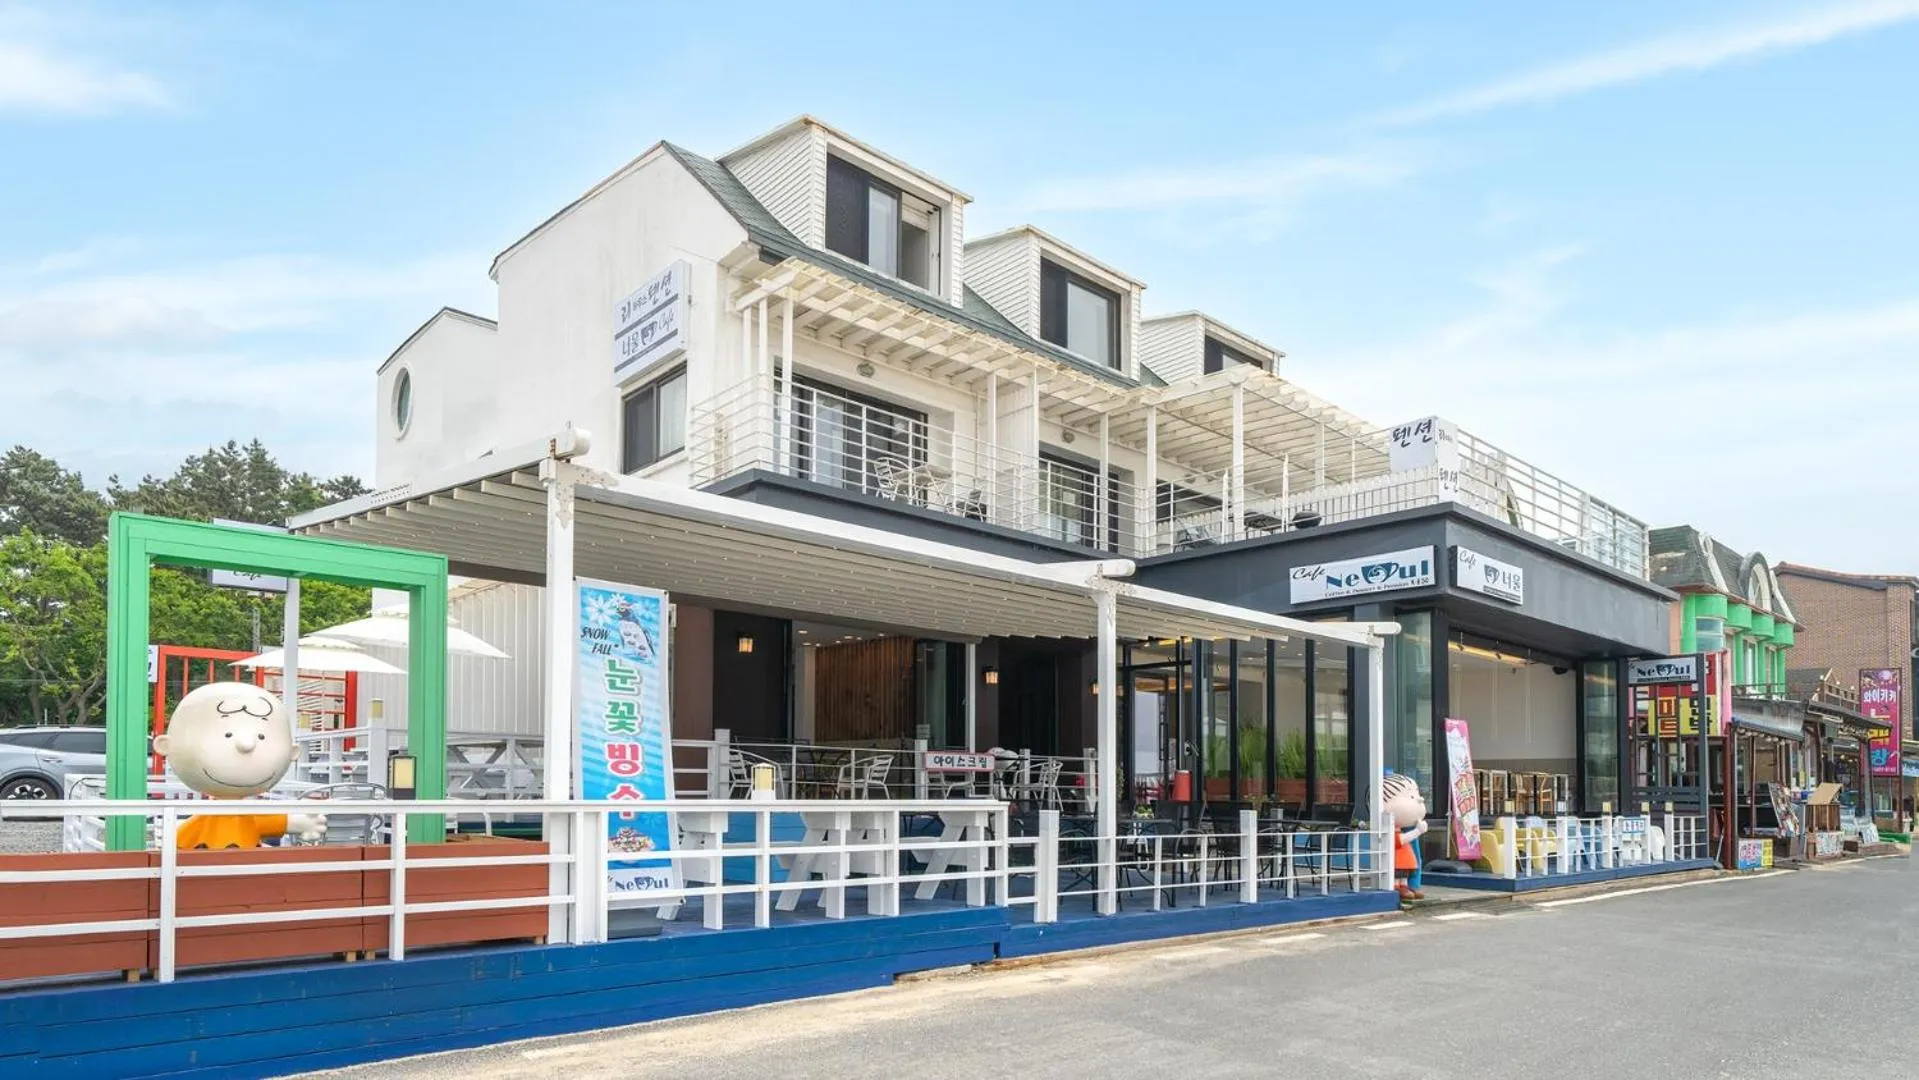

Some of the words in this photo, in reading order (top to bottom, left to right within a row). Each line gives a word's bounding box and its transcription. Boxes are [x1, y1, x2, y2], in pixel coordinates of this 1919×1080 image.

[1460, 550, 1476, 570] Cafe
[1292, 566, 1326, 581] Cafe
[580, 627, 609, 640] SNOW
[933, 755, 987, 769] 아이스크림
